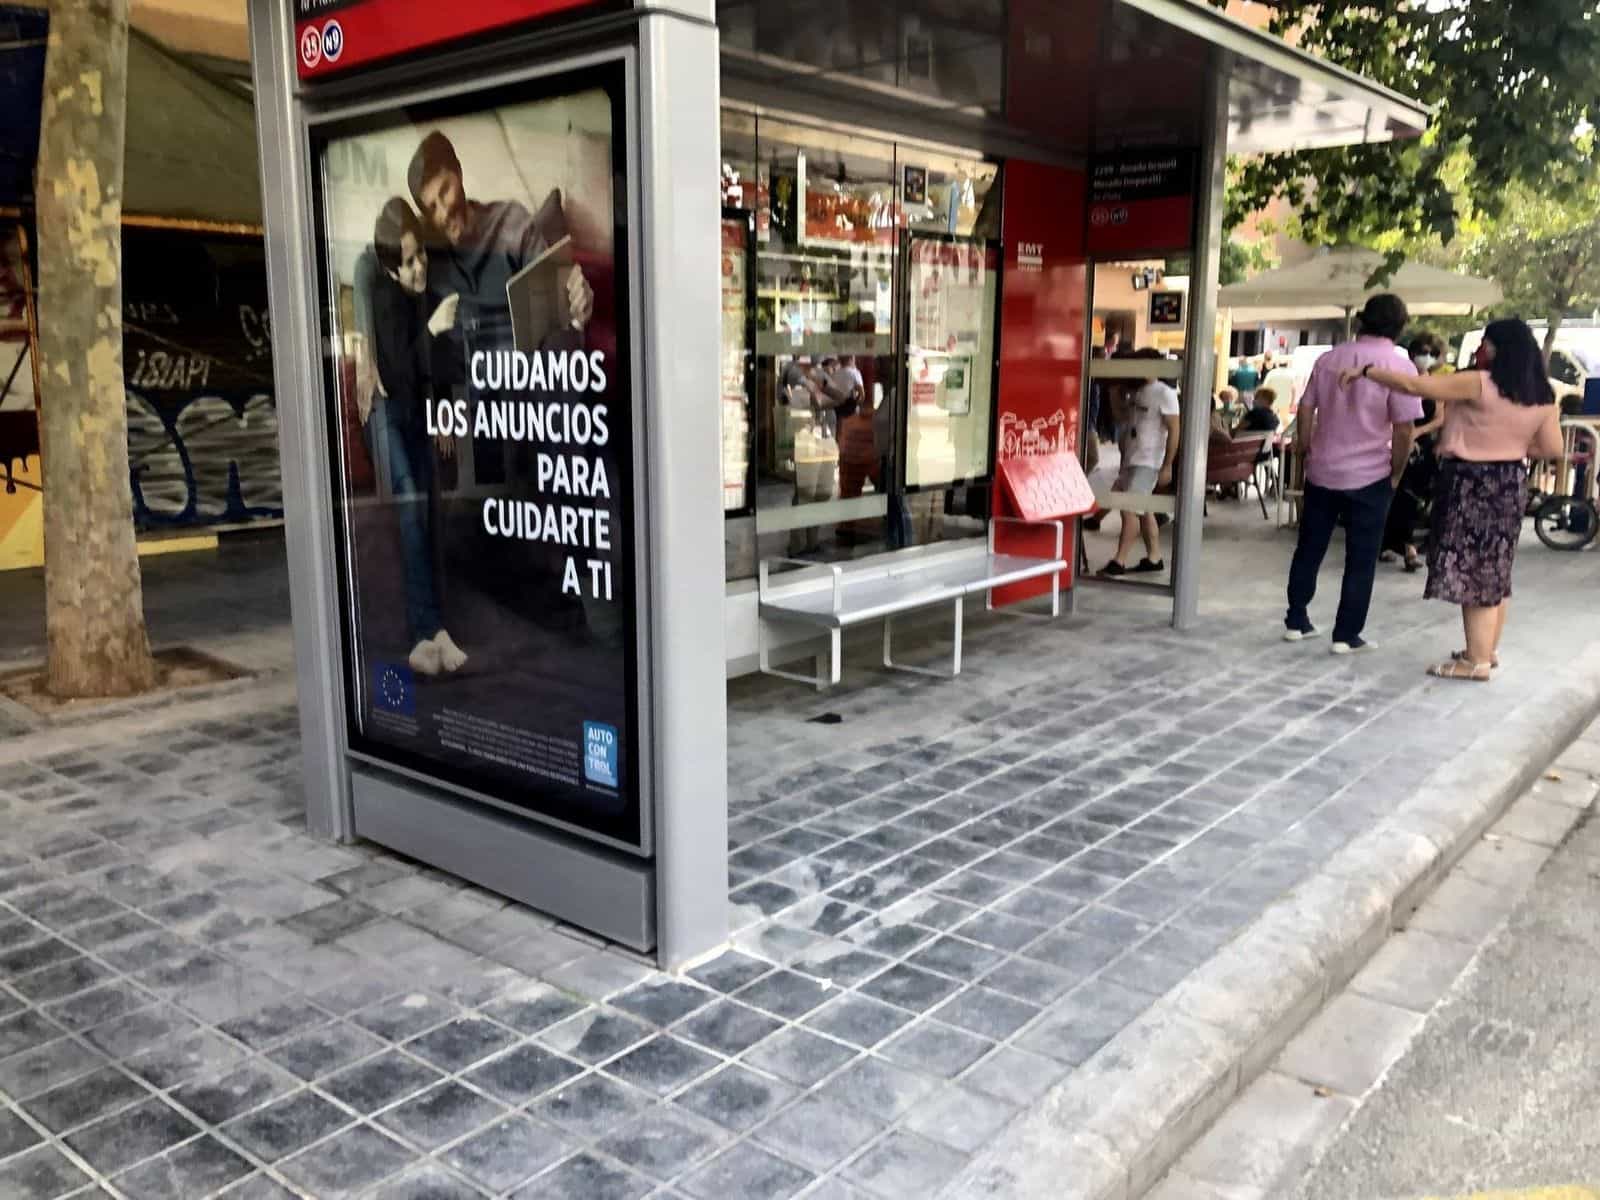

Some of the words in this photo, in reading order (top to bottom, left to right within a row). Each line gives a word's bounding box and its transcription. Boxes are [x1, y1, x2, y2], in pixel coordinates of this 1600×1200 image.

[324, 26, 341, 53] N9
[1017, 241, 1044, 256] EMT
[471, 349, 607, 393] CUIDAMOS
[426, 398, 468, 438] LOS
[473, 400, 609, 446] ANUNCIOS
[537, 452, 611, 499] PARA
[483, 496, 611, 551] CUIDARTE
[561, 555, 582, 596] A
[587, 558, 612, 601] TI
[588, 726, 613, 745] AUTO
[588, 742, 608, 759] CON
[588, 757, 613, 778] TROL
